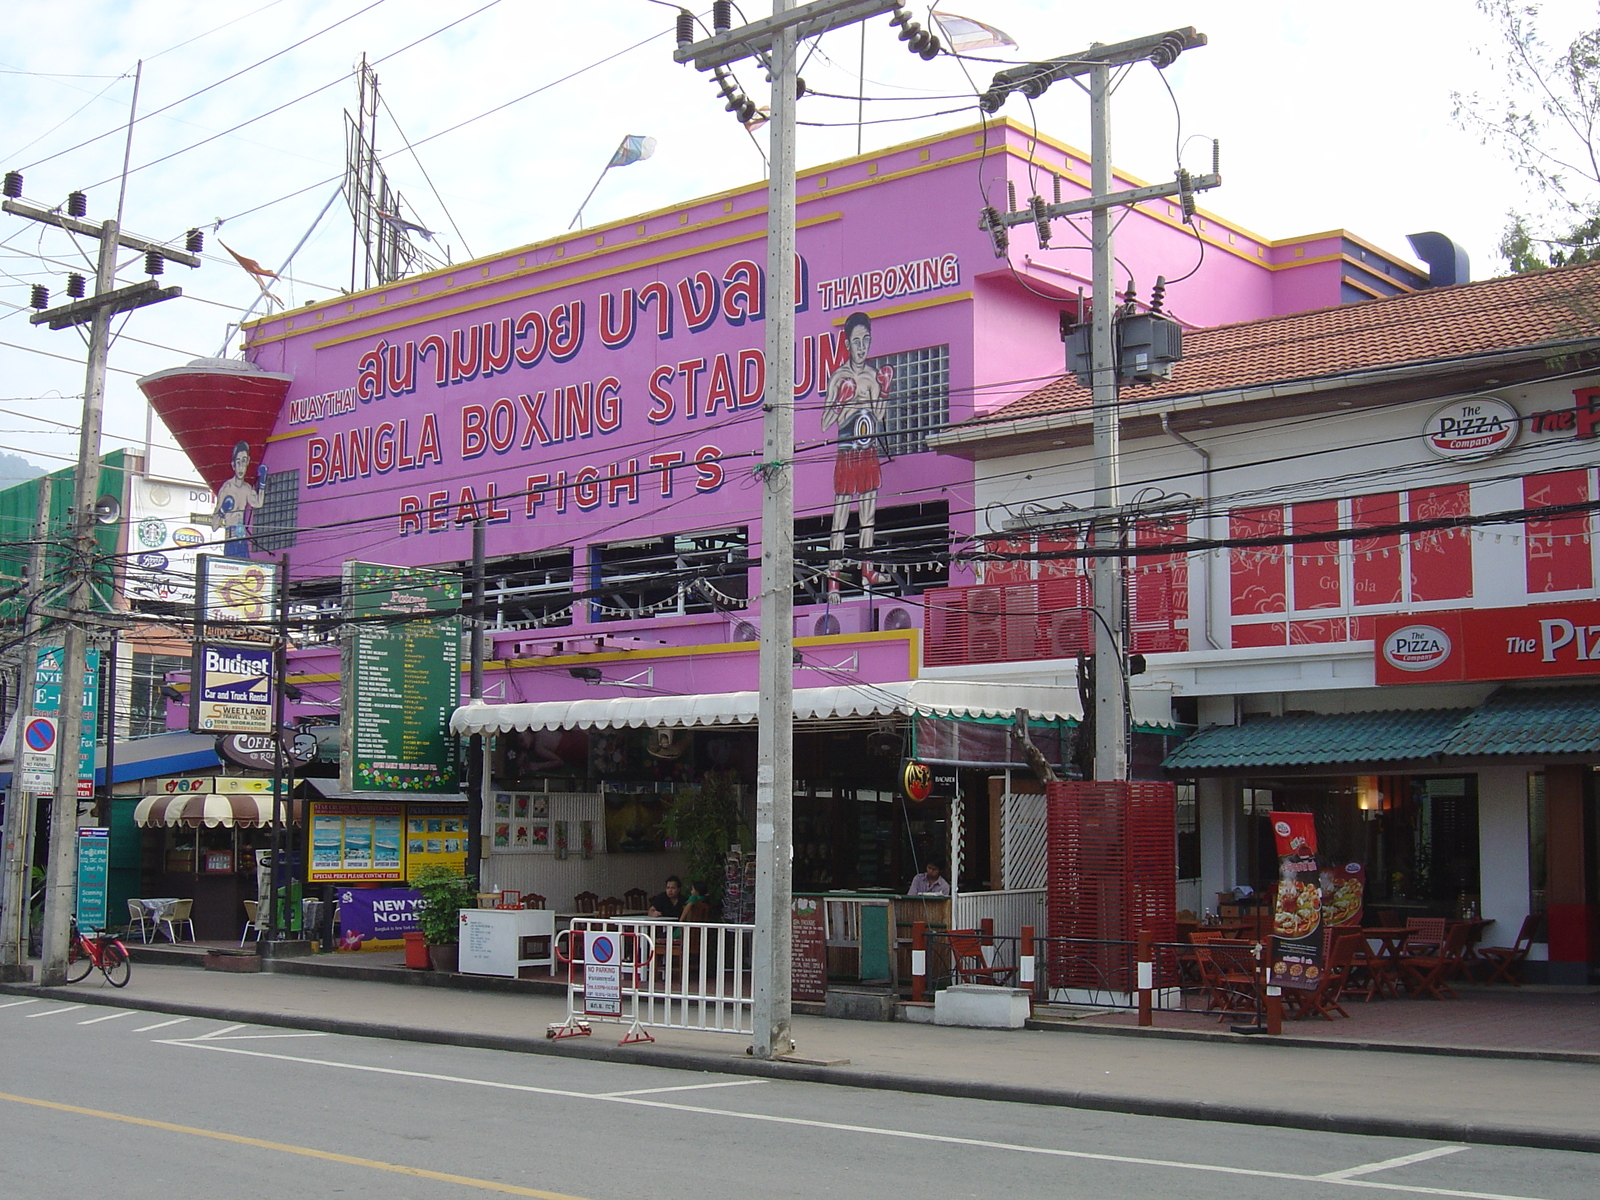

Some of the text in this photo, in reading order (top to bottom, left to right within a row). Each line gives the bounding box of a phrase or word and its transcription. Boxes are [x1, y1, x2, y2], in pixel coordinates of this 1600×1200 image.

[306, 329, 848, 487] BANGLA BOXING STADUM
[1462, 406, 1481, 418] The
[1440, 415, 1503, 438] PIZZA
[1531, 410, 1575, 433] The
[1450, 436, 1493, 449] Company
[399, 480, 508, 534] REAL
[175, 534, 203, 543] FOSSIL
[1320, 576, 1376, 592] Goola
[1411, 632, 1425, 640] The
[1396, 638, 1440, 654] PIZZA
[1506, 637, 1536, 654] The
[206, 651, 270, 679] Budget
[1403, 653, 1432, 662] Company
[205, 689, 268, 702] Car and Truck Rental
[207, 704, 267, 718] SWEETLAND
[233, 734, 279, 753] COFFE
[364, 872, 386, 880] CONTACT
[386, 872, 399, 880] HERE
[373, 900, 405, 912] NEW
